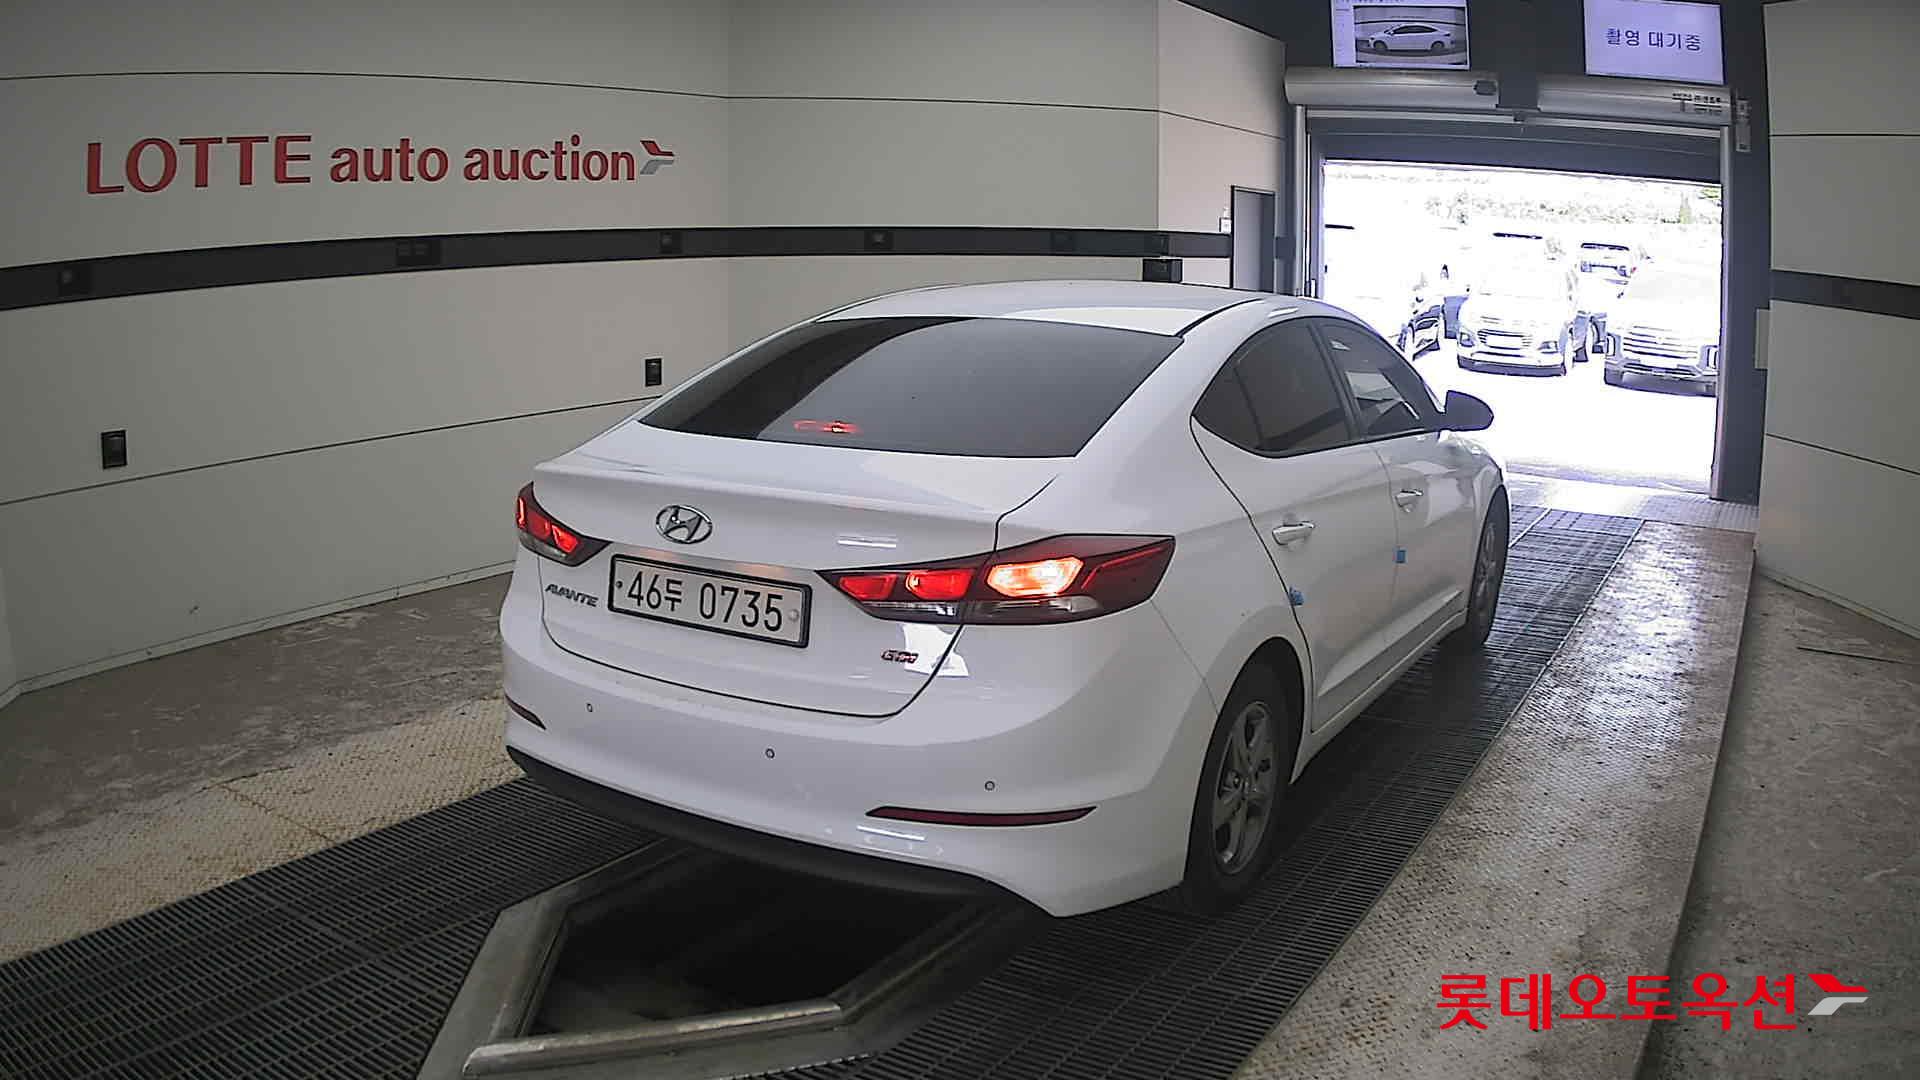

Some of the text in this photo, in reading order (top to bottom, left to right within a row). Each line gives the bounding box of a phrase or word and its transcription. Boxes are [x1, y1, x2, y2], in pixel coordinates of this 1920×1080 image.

[1648, 31, 1701, 52] 대기중
[86, 133, 636, 195] LOTTE auto auction
[544, 583, 599, 608] AVANTE
[627, 571, 784, 632] 46두 0735
